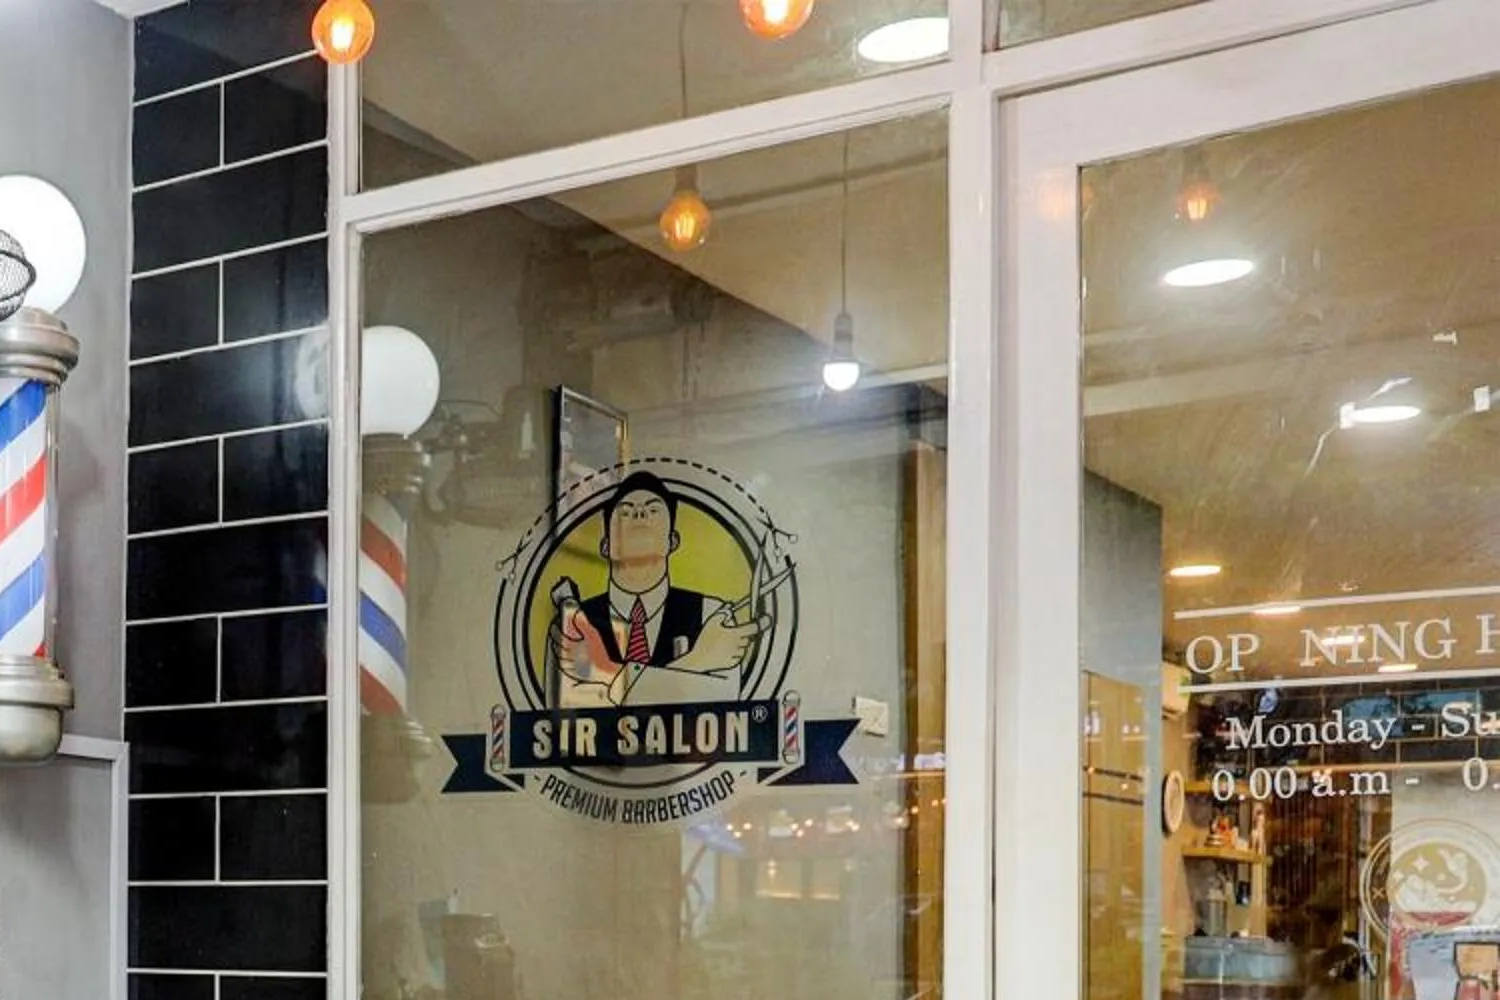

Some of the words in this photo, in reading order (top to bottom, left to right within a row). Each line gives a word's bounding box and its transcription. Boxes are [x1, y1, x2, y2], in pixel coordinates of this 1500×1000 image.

[533, 717, 597, 759] SIR
[1225, 707, 1398, 750] Monday
[539, 774, 618, 823] PREMIUM
[621, 769, 736, 825] BARBERSHOP
